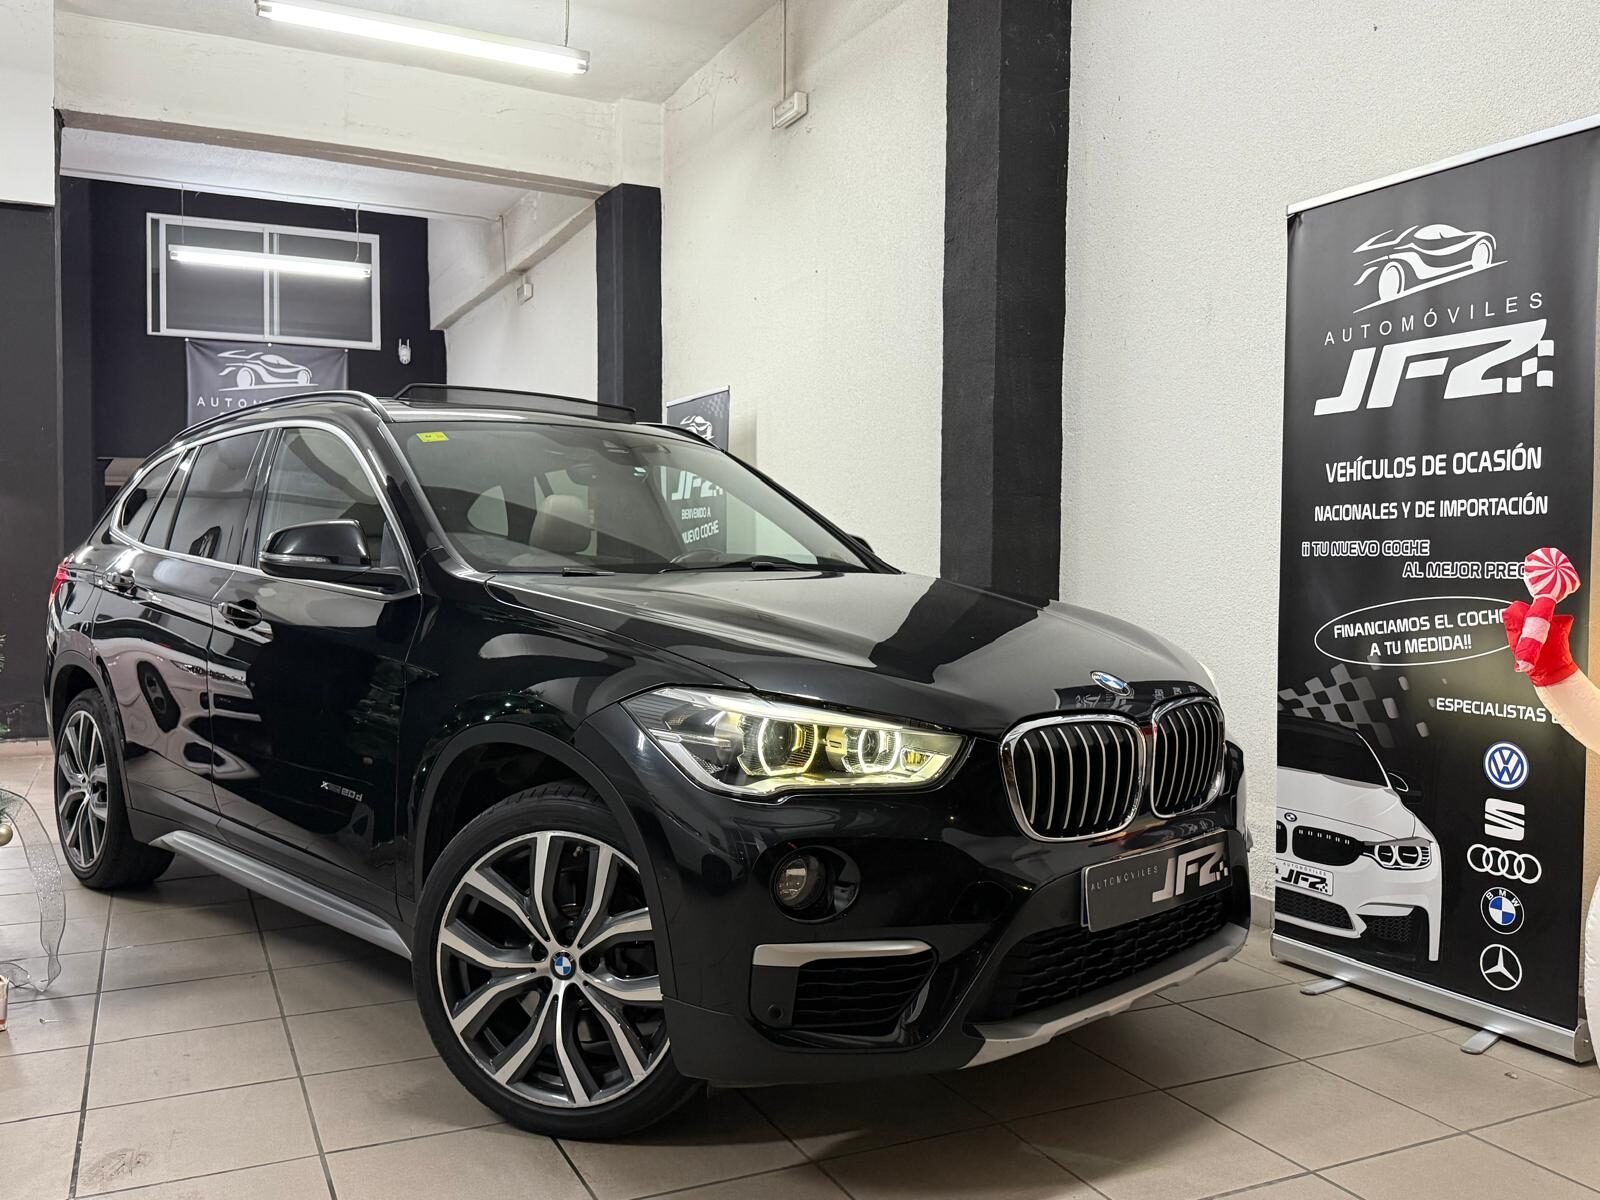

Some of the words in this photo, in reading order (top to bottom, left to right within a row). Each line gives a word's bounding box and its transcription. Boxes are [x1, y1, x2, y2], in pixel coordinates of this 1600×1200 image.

[1324, 292, 1544, 346] AUTOMÓVILES
[1325, 456, 1416, 483] VEHÍCULOS
[1421, 454, 1447, 477] DE
[1452, 443, 1542, 475] OCASIÓN
[1314, 503, 1398, 522] NACIONALES
[1401, 501, 1412, 518] Y
[1414, 500, 1436, 518] DE
[1439, 492, 1548, 518] IMPORTACIÓN
[700, 520, 719, 538] COCHE
[1311, 541, 1329, 557] TU
[1330, 540, 1380, 557] NUEVO
[1382, 540, 1430, 557] COCHE
[1402, 562, 1424, 578] AL
[1426, 561, 1482, 579] MEJOR
[1334, 616, 1430, 639] FINANCIAMOS
[1434, 614, 1454, 629] EL
[1369, 642, 1382, 657] A
[1384, 640, 1402, 655] TU
[1404, 634, 1473, 655] MEDIDA!!
[1436, 697, 1547, 723] ESPECIALISTAS
[1486, 889, 1521, 907] BMW
